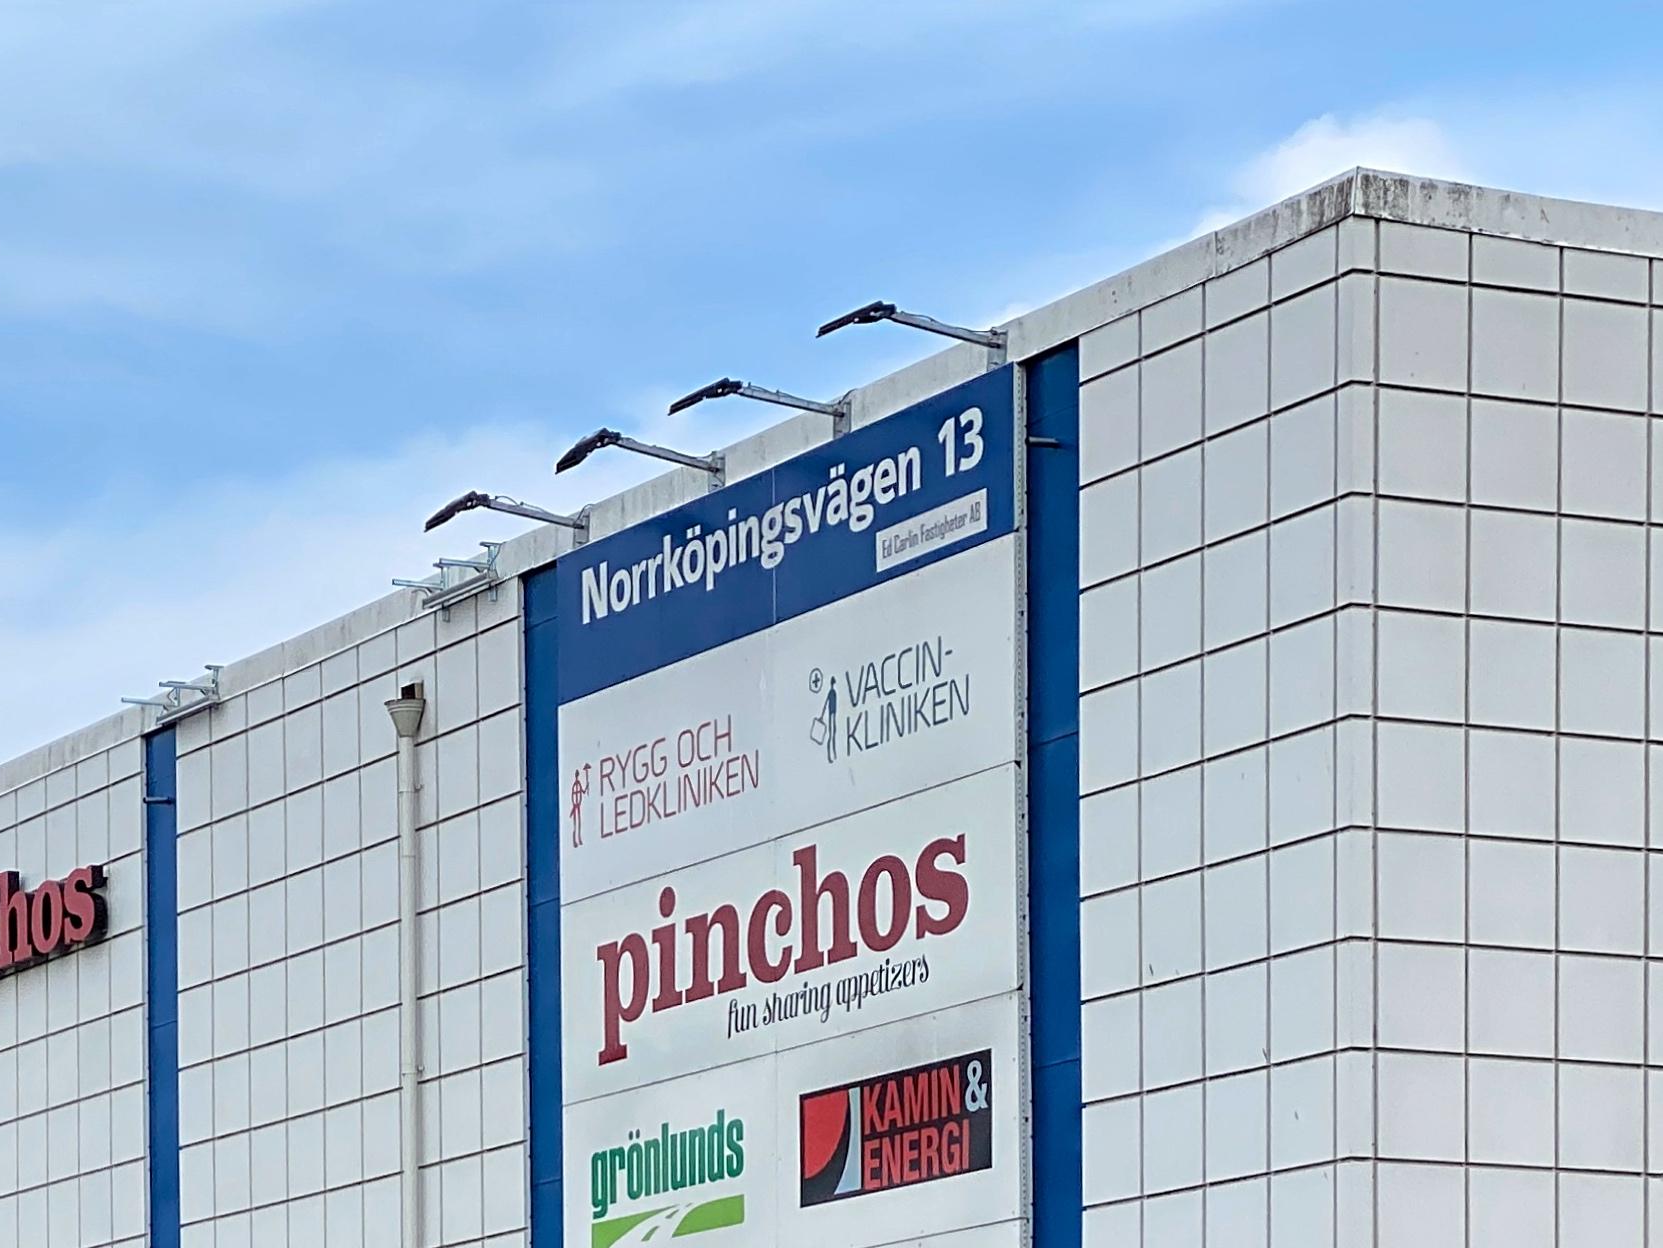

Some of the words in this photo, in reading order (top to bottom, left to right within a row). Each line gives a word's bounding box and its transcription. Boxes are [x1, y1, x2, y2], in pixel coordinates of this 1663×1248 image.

[582, 446, 921, 625] Norrköpingsvägen
[938, 405, 985, 478] 13
[920, 513, 968, 544] Fastigheter
[969, 501, 982, 524] AB
[845, 635, 953, 708] VACCIN-
[600, 737, 668, 797] RYGG
[677, 713, 732, 769] OCH
[847, 673, 970, 757] KLINIKEN
[600, 748, 759, 839] LEDKLINIKEN
[597, 833, 970, 1067] pinchos
[727, 997, 759, 1040] fun
[762, 981, 832, 1024] sharing
[836, 953, 930, 1013] appetizers
[863, 1068, 961, 1134] KAMIN
[964, 1058, 989, 1112] &
[591, 1108, 745, 1220] grönlunds
[863, 1118, 971, 1191] ENERGI
